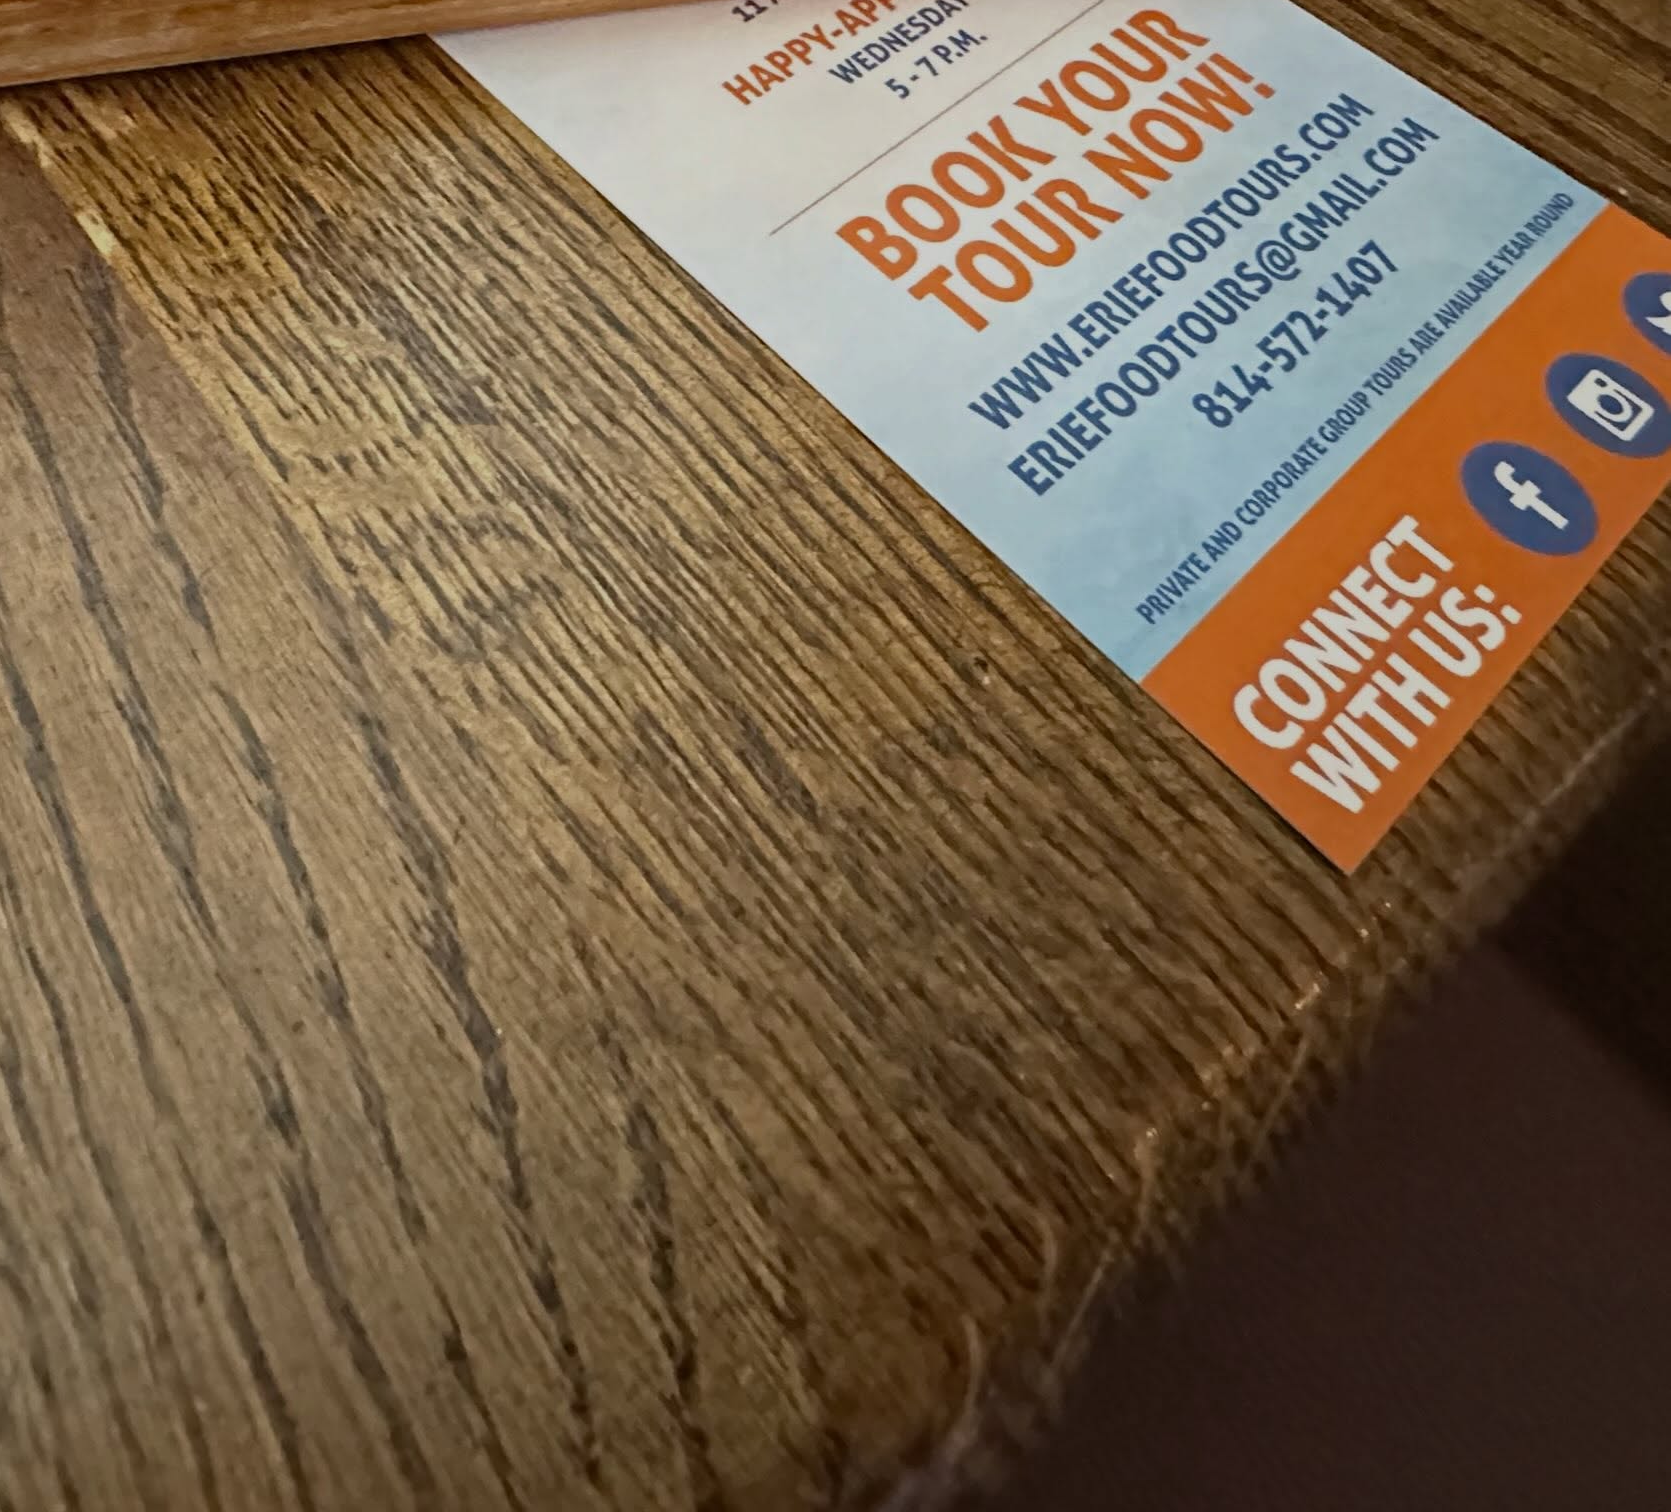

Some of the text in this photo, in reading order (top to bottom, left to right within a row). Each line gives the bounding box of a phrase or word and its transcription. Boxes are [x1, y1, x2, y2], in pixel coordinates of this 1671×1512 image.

[836, 9, 1209, 281] BOOK YOUR
[885, 76, 911, 100] 5
[914, 55, 939, 78] 7
[931, 28, 989, 65] P.M.
[908, 52, 1275, 333] TOUR NOW!
[969, 92, 1375, 431] WWW.ERIEFOODTOURS.COM
[1007, 117, 1441, 496] ERIEFOODTOURS@GMAIL.COM
[1192, 240, 1400, 429] 814-572-1407
[1135, 192, 1574, 625] PRIVATE AND CORPORATE GROUP TOURS ARE AVAILABLE YEAR ROUND
[1233, 514, 1454, 750] CONNECT
[1290, 583, 1523, 815] WITH US:
